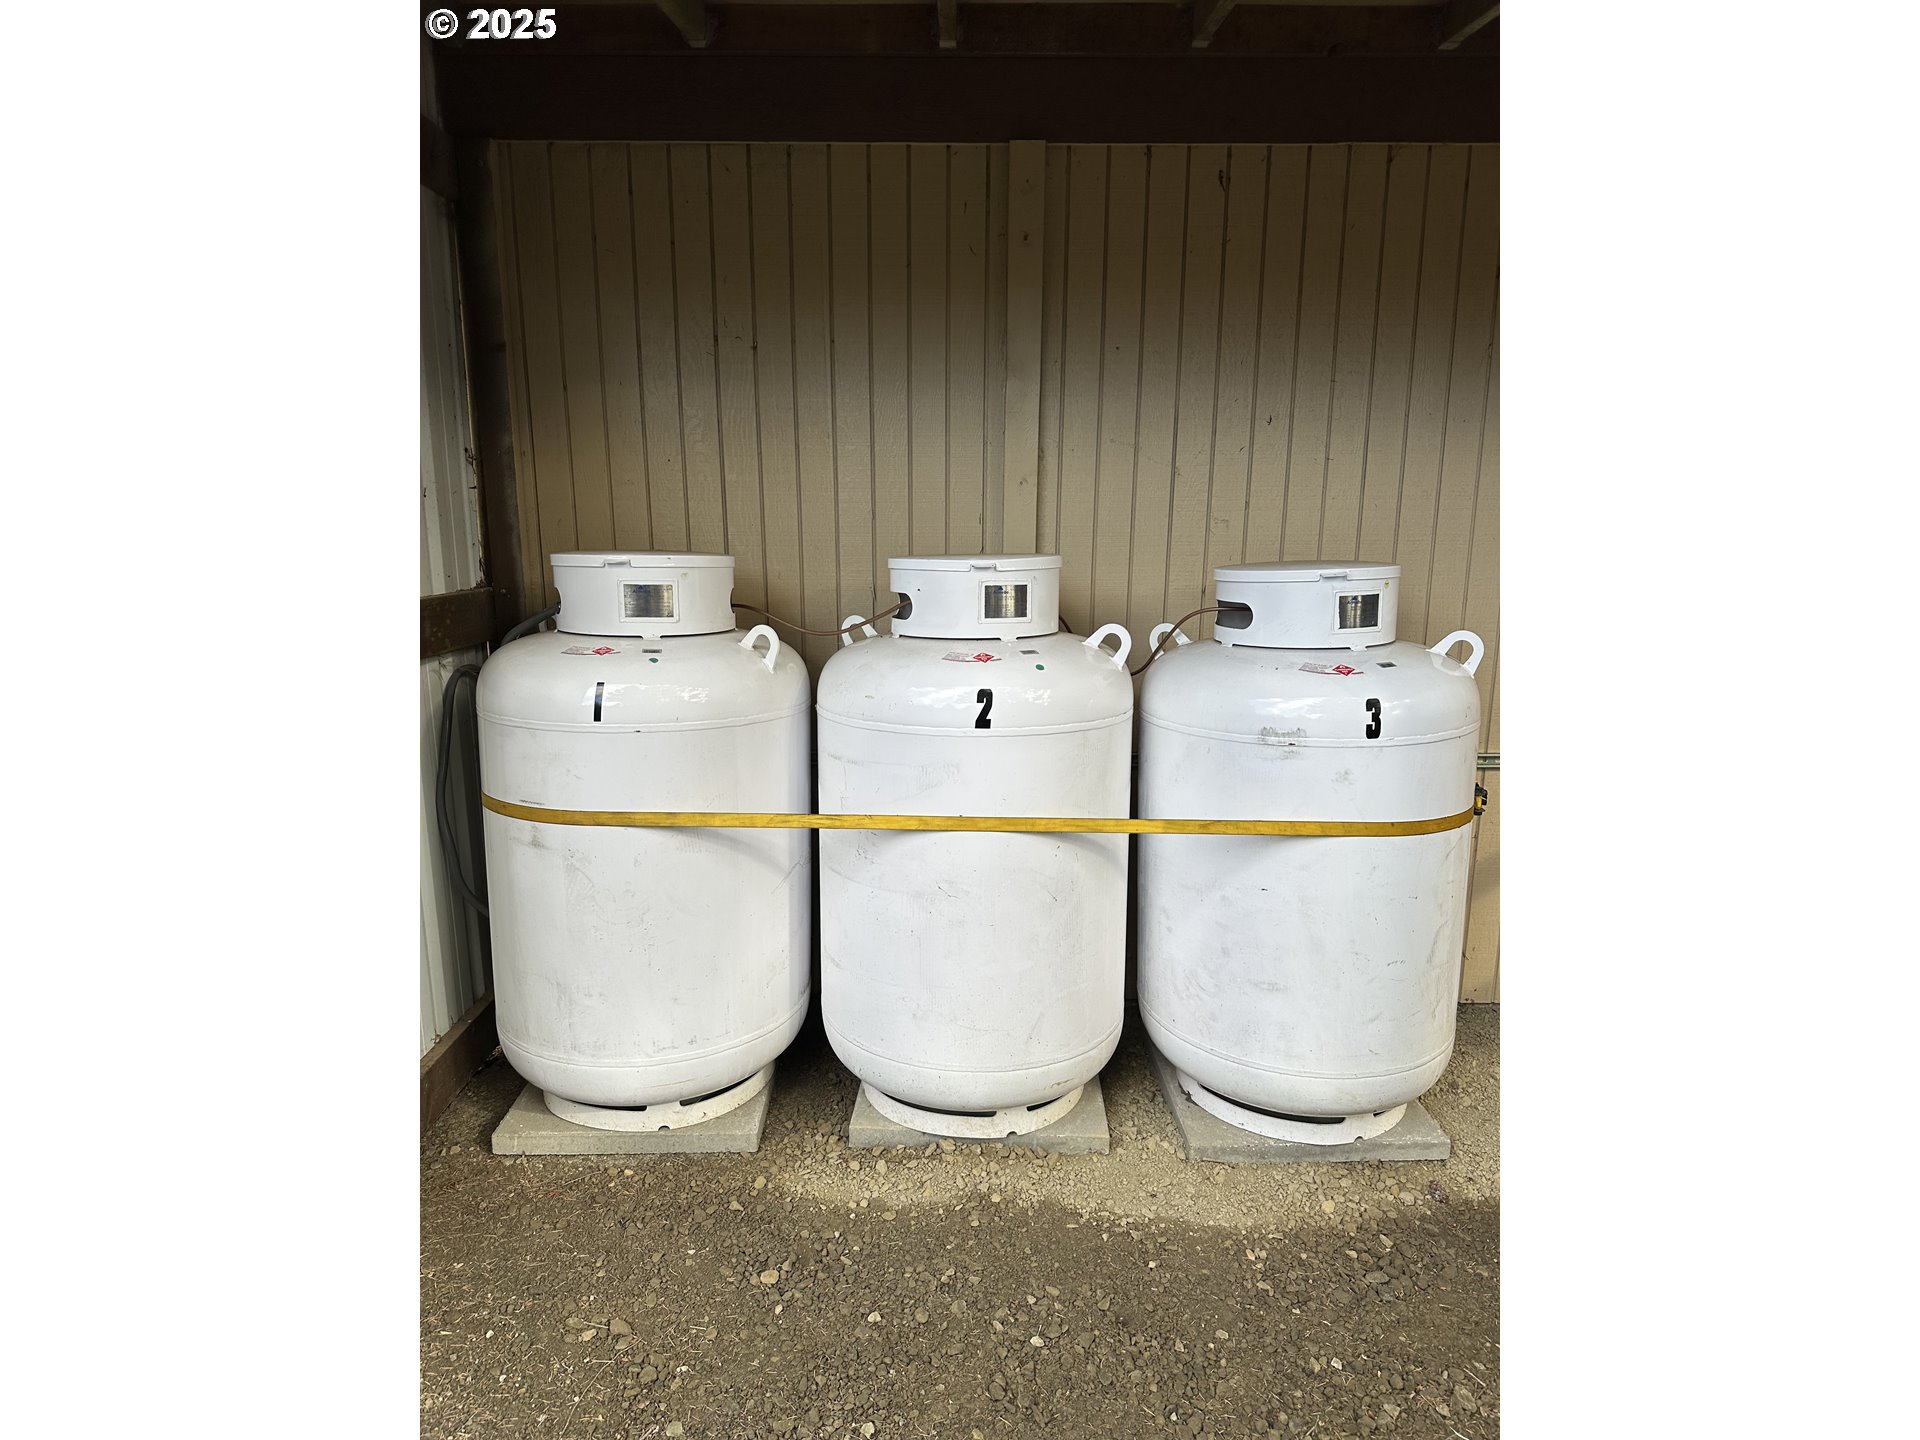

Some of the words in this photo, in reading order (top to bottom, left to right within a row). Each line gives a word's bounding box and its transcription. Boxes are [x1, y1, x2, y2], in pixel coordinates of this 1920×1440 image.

[593, 682, 606, 722] 1
[975, 688, 993, 729] 2
[1365, 698, 1382, 740] 3
